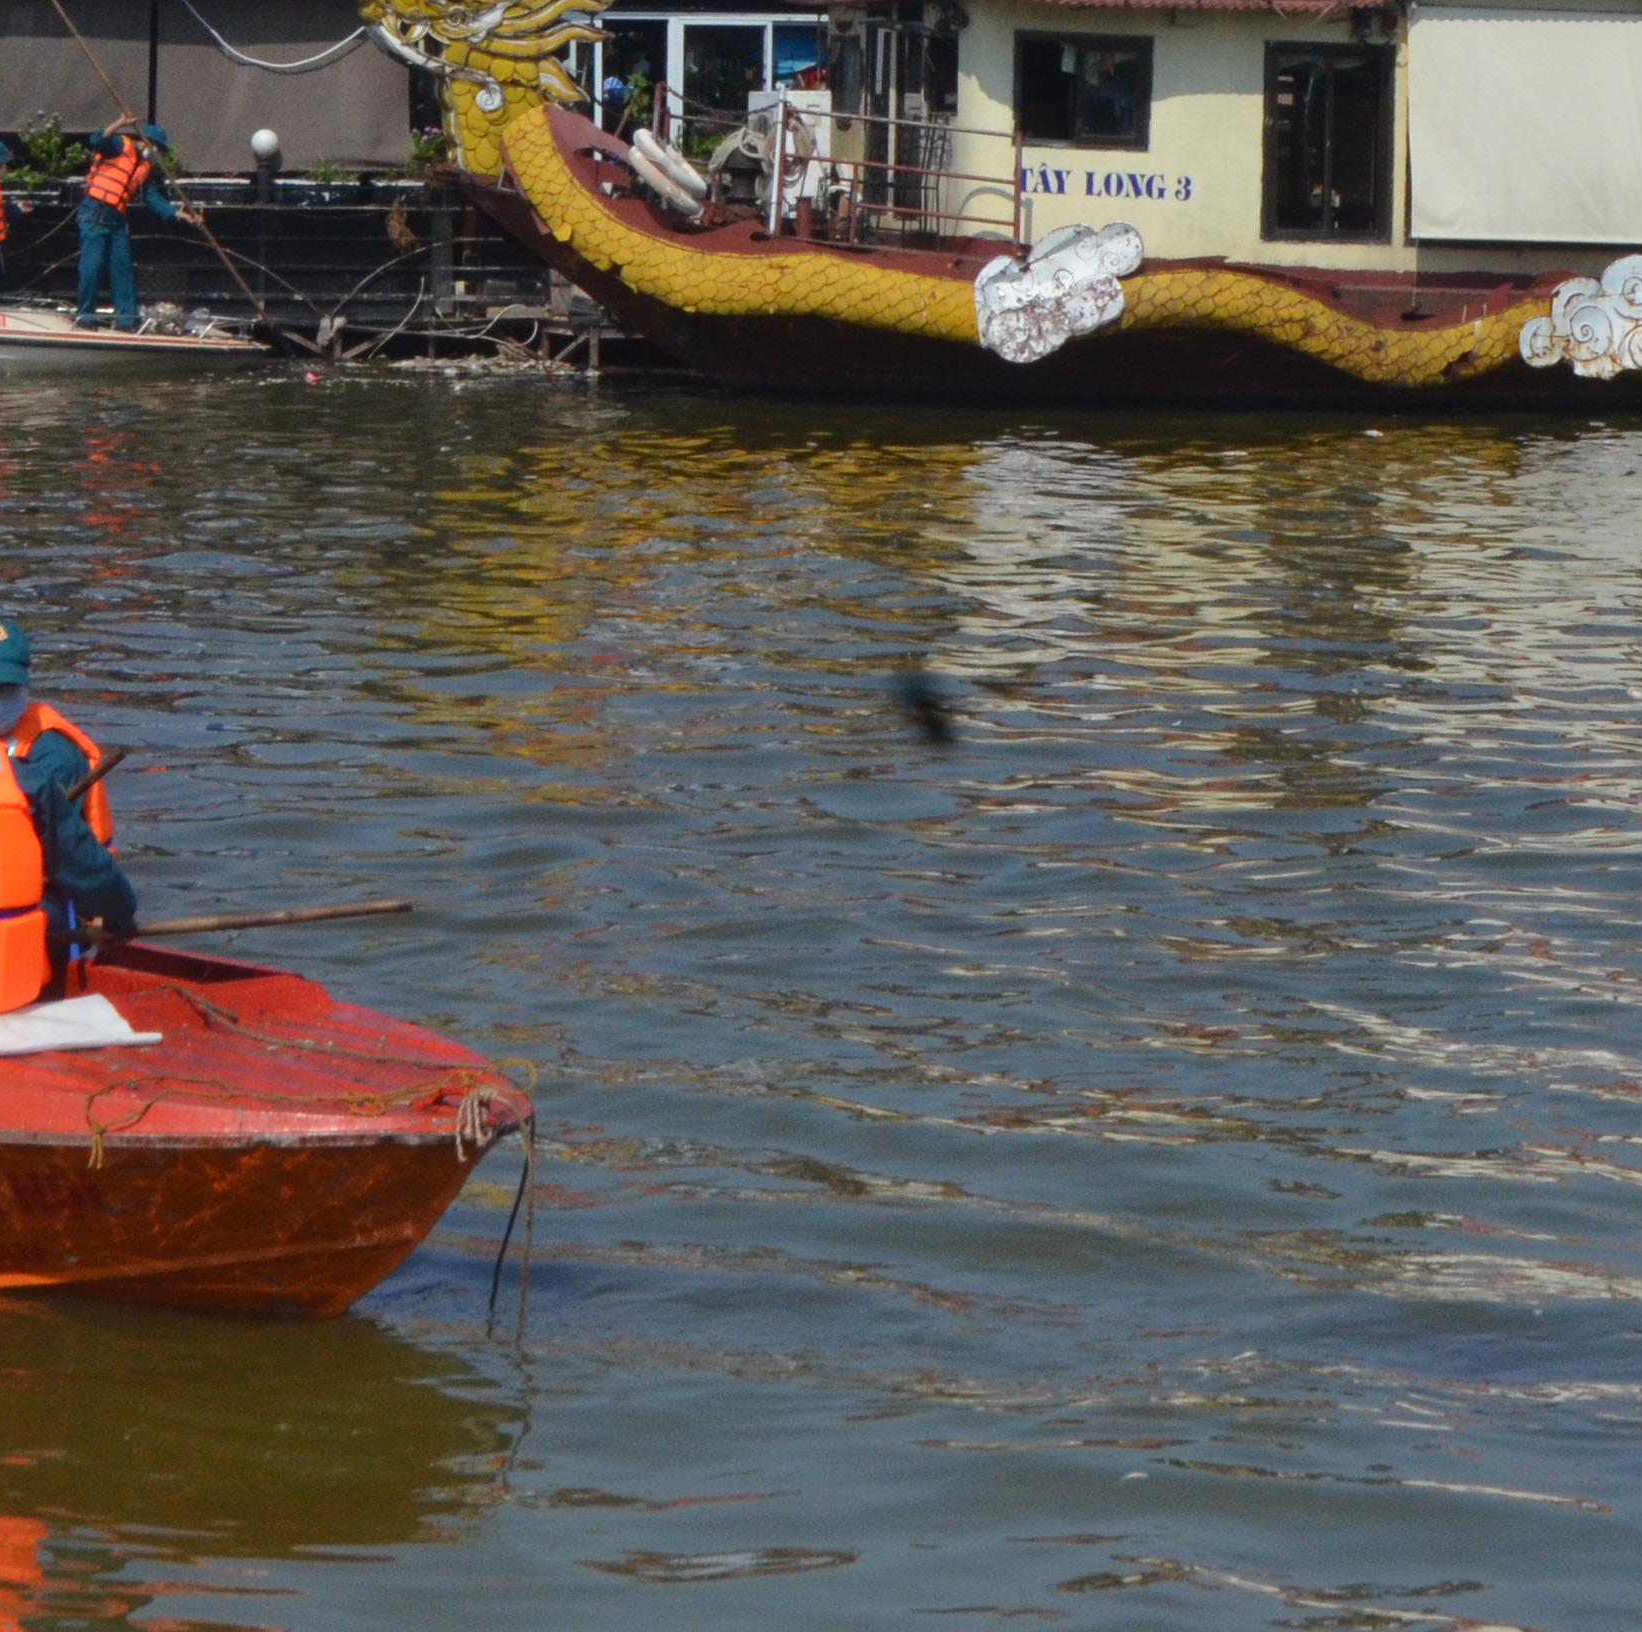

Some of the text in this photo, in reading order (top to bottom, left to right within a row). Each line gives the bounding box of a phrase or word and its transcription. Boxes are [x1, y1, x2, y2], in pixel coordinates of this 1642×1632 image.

[1020, 162, 1192, 201] TÂY LONG 3
